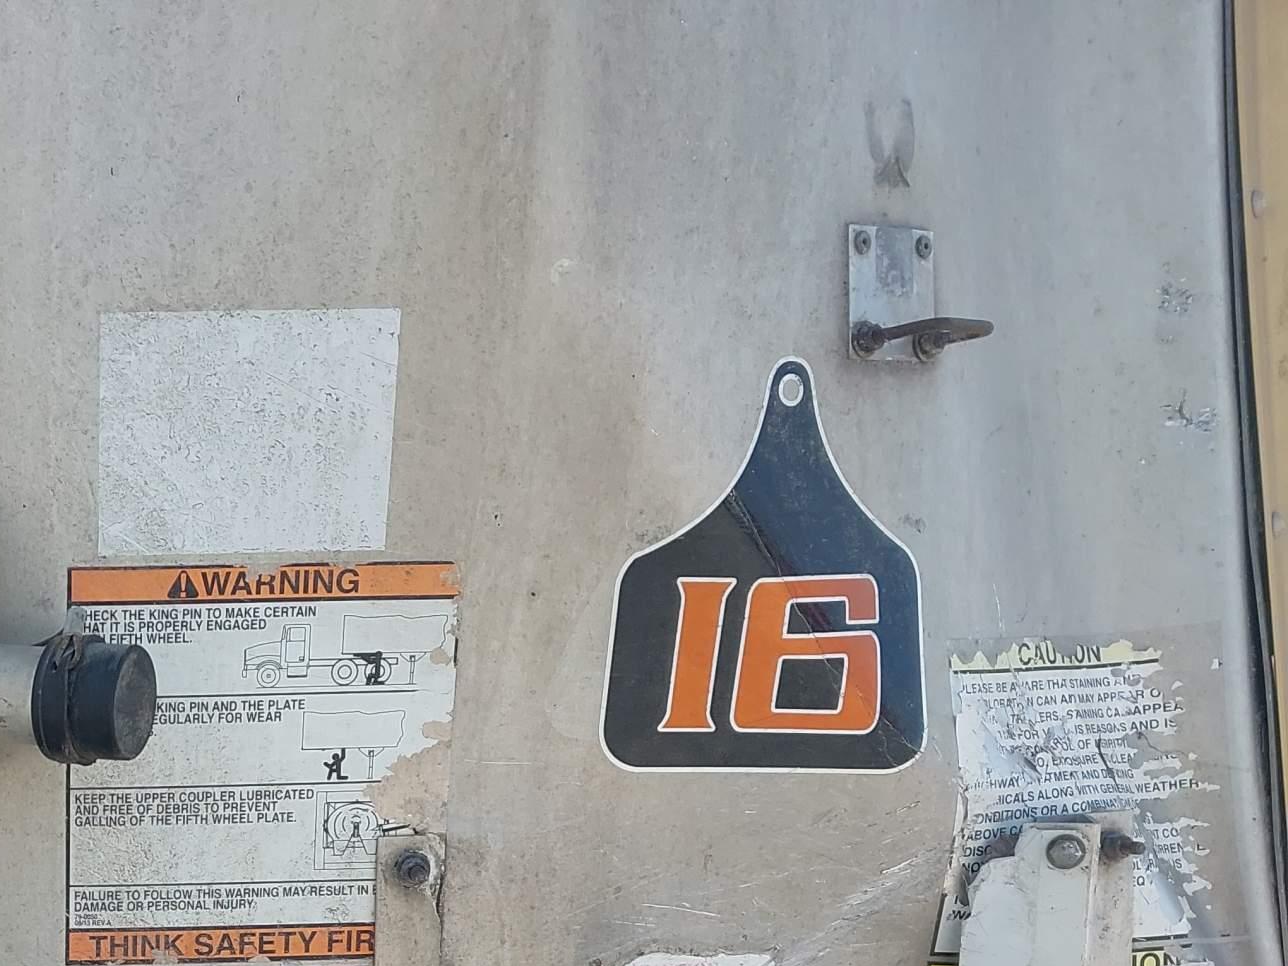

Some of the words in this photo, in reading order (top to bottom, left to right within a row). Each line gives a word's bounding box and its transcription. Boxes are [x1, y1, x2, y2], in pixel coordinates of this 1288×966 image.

[201, 568, 360, 597] WARNING
[85, 610, 118, 621] HECK
[121, 609, 145, 621] THE
[149, 608, 179, 620] KING
[182, 608, 202, 619] PIN
[206, 608, 222, 619] TO
[225, 607, 260, 619] MAKE
[264, 606, 317, 618] CERTAIN
[83, 621, 107, 633] HAT
[109, 621, 120, 633] IT
[123, 621, 135, 632] IS
[138, 620, 203, 632] PROPERLY
[206, 619, 267, 631] ENGAGED
[110, 633, 143, 645] FIFTH
[146, 632, 193, 644] WHEEL.
[657, 573, 881, 735] 16
[1017, 641, 1102, 666] CAUON
[156, 701, 186, 713] KING
[189, 702, 209, 712] PIN
[213, 701, 237, 712] AND
[241, 700, 265, 711] THE
[268, 699, 306, 711] PLATE
[153, 713, 214, 725] EGULARLY
[218, 712, 243, 724] FOR
[246, 712, 282, 723] WEAR
[1130, 719, 1160, 732] AND
[1134, 778, 1200, 794] WEATHER
[74, 793, 106, 805] KEEP
[109, 793, 132, 804] THE
[136, 792, 176, 803] UPPER
[178, 791, 236, 802] COUPLER
[239, 789, 315, 801] LUBRICATED
[74, 805, 99, 816] AND
[102, 805, 134, 815] FREE
[137, 804, 153, 815] OF
[156, 803, 201, 815] DEBRIS
[205, 802, 221, 813] TO
[223, 801, 278, 813] PREVENT
[1040, 804, 1058, 816] OR
[1061, 803, 1069, 815] A
[74, 816, 126, 827] GALLING
[129, 815, 146, 827] OF
[150, 815, 173, 826] THE
[175, 814, 208, 826] FIFTH
[211, 813, 254, 825] WHEEL
[256, 812, 298, 824] PLATE.
[74, 890, 122, 902] FAILURE
[125, 890, 141, 901] TO
[143, 889, 194, 900] FOLLOW
[196, 888, 222, 900] THIS
[225, 888, 280, 899] WARNING
[282, 887, 308, 898] MAY
[309, 885, 354, 897] RESULT
[357, 885, 369, 896] IN
[74, 901, 124, 913] DAMAGE
[127, 901, 144, 912] OR
[147, 899, 210, 912] PERSONAL
[89, 934, 184, 957] THINK
[193, 930, 317, 956] SAFETY
